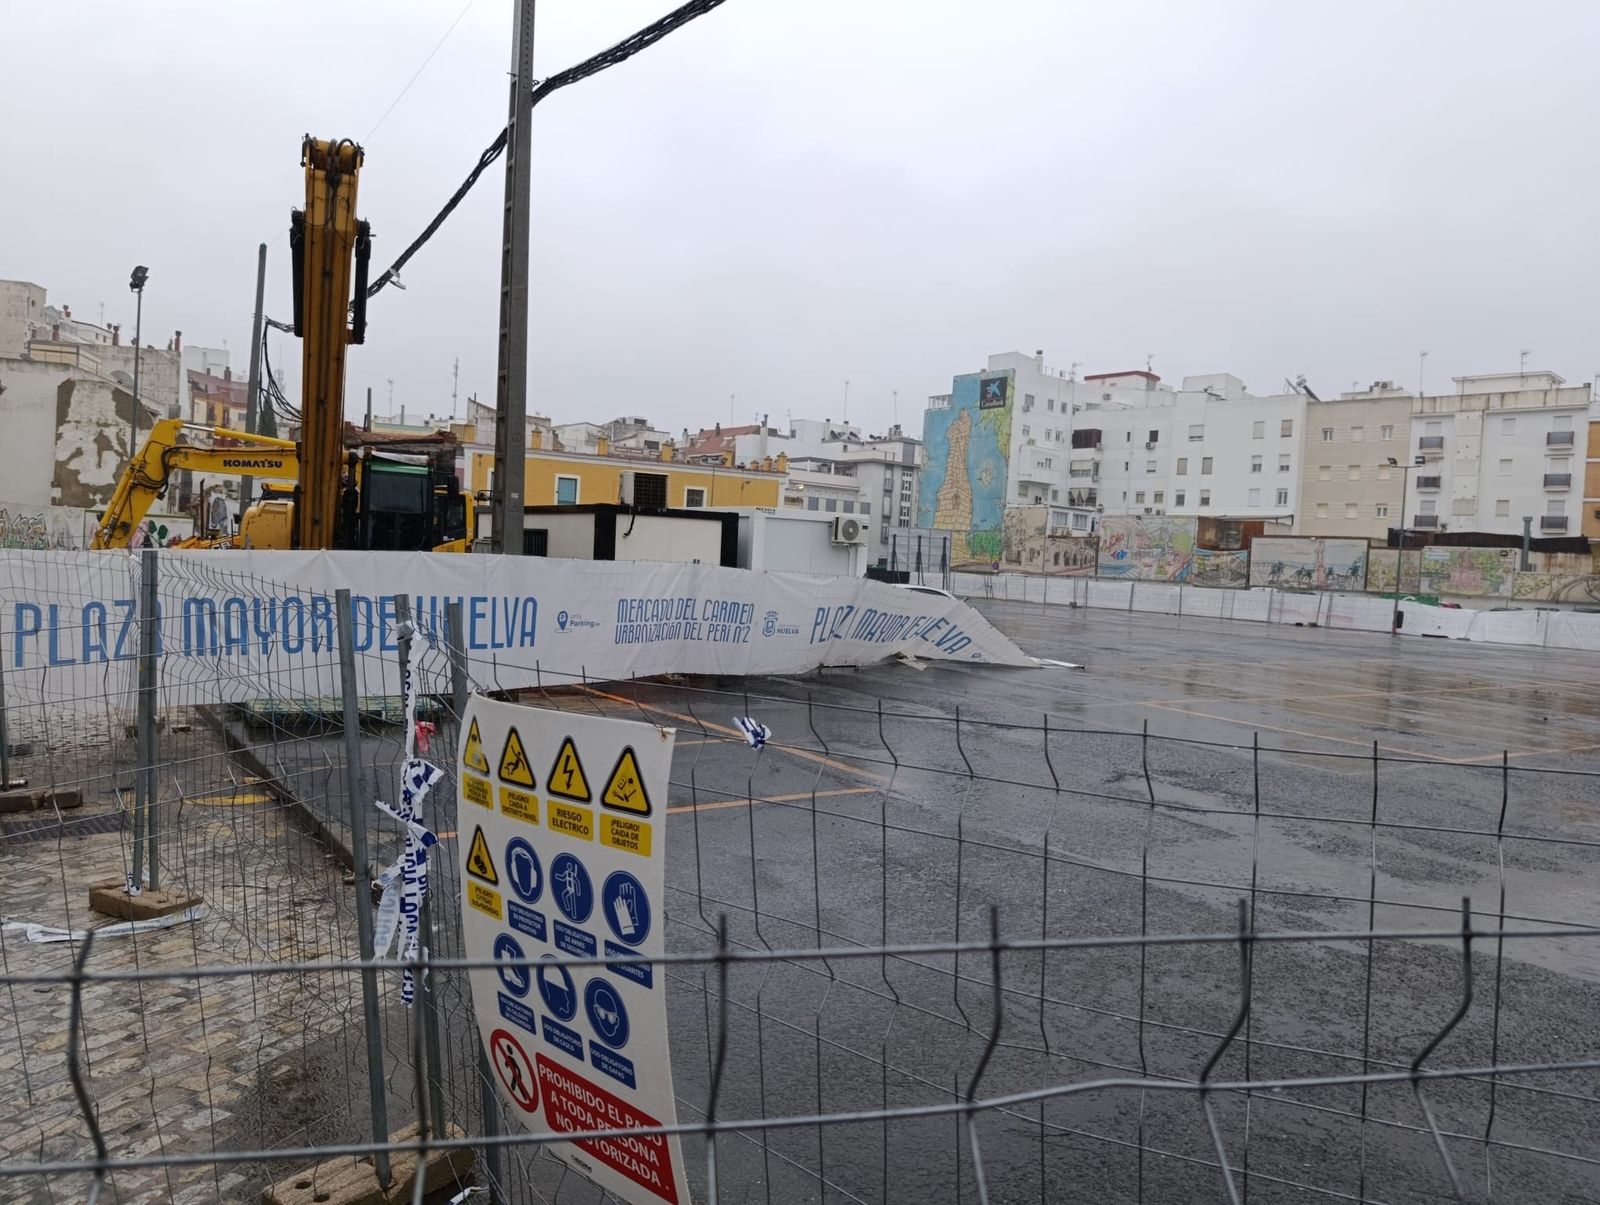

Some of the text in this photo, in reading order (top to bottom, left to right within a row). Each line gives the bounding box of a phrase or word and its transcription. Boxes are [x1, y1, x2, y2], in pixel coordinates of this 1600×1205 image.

[223, 459, 282, 468] KOMATSU
[616, 598, 755, 625] MERCADO DEL CARMEN
[183, 596, 334, 656] MAYOR
[683, 621, 703, 641] DEL
[556, 807, 582, 822] RIESGO
[611, 819, 640, 832] ¡PELIGRO!
[612, 836, 638, 850] OBJETOS
[630, 832, 639, 841] DE
[539, 1064, 605, 1113] PROHIBIDO
[608, 1103, 623, 1125] EL
[551, 1090, 559, 1106] A
[560, 1095, 595, 1128] TODA
[556, 1111, 573, 1132] NO
